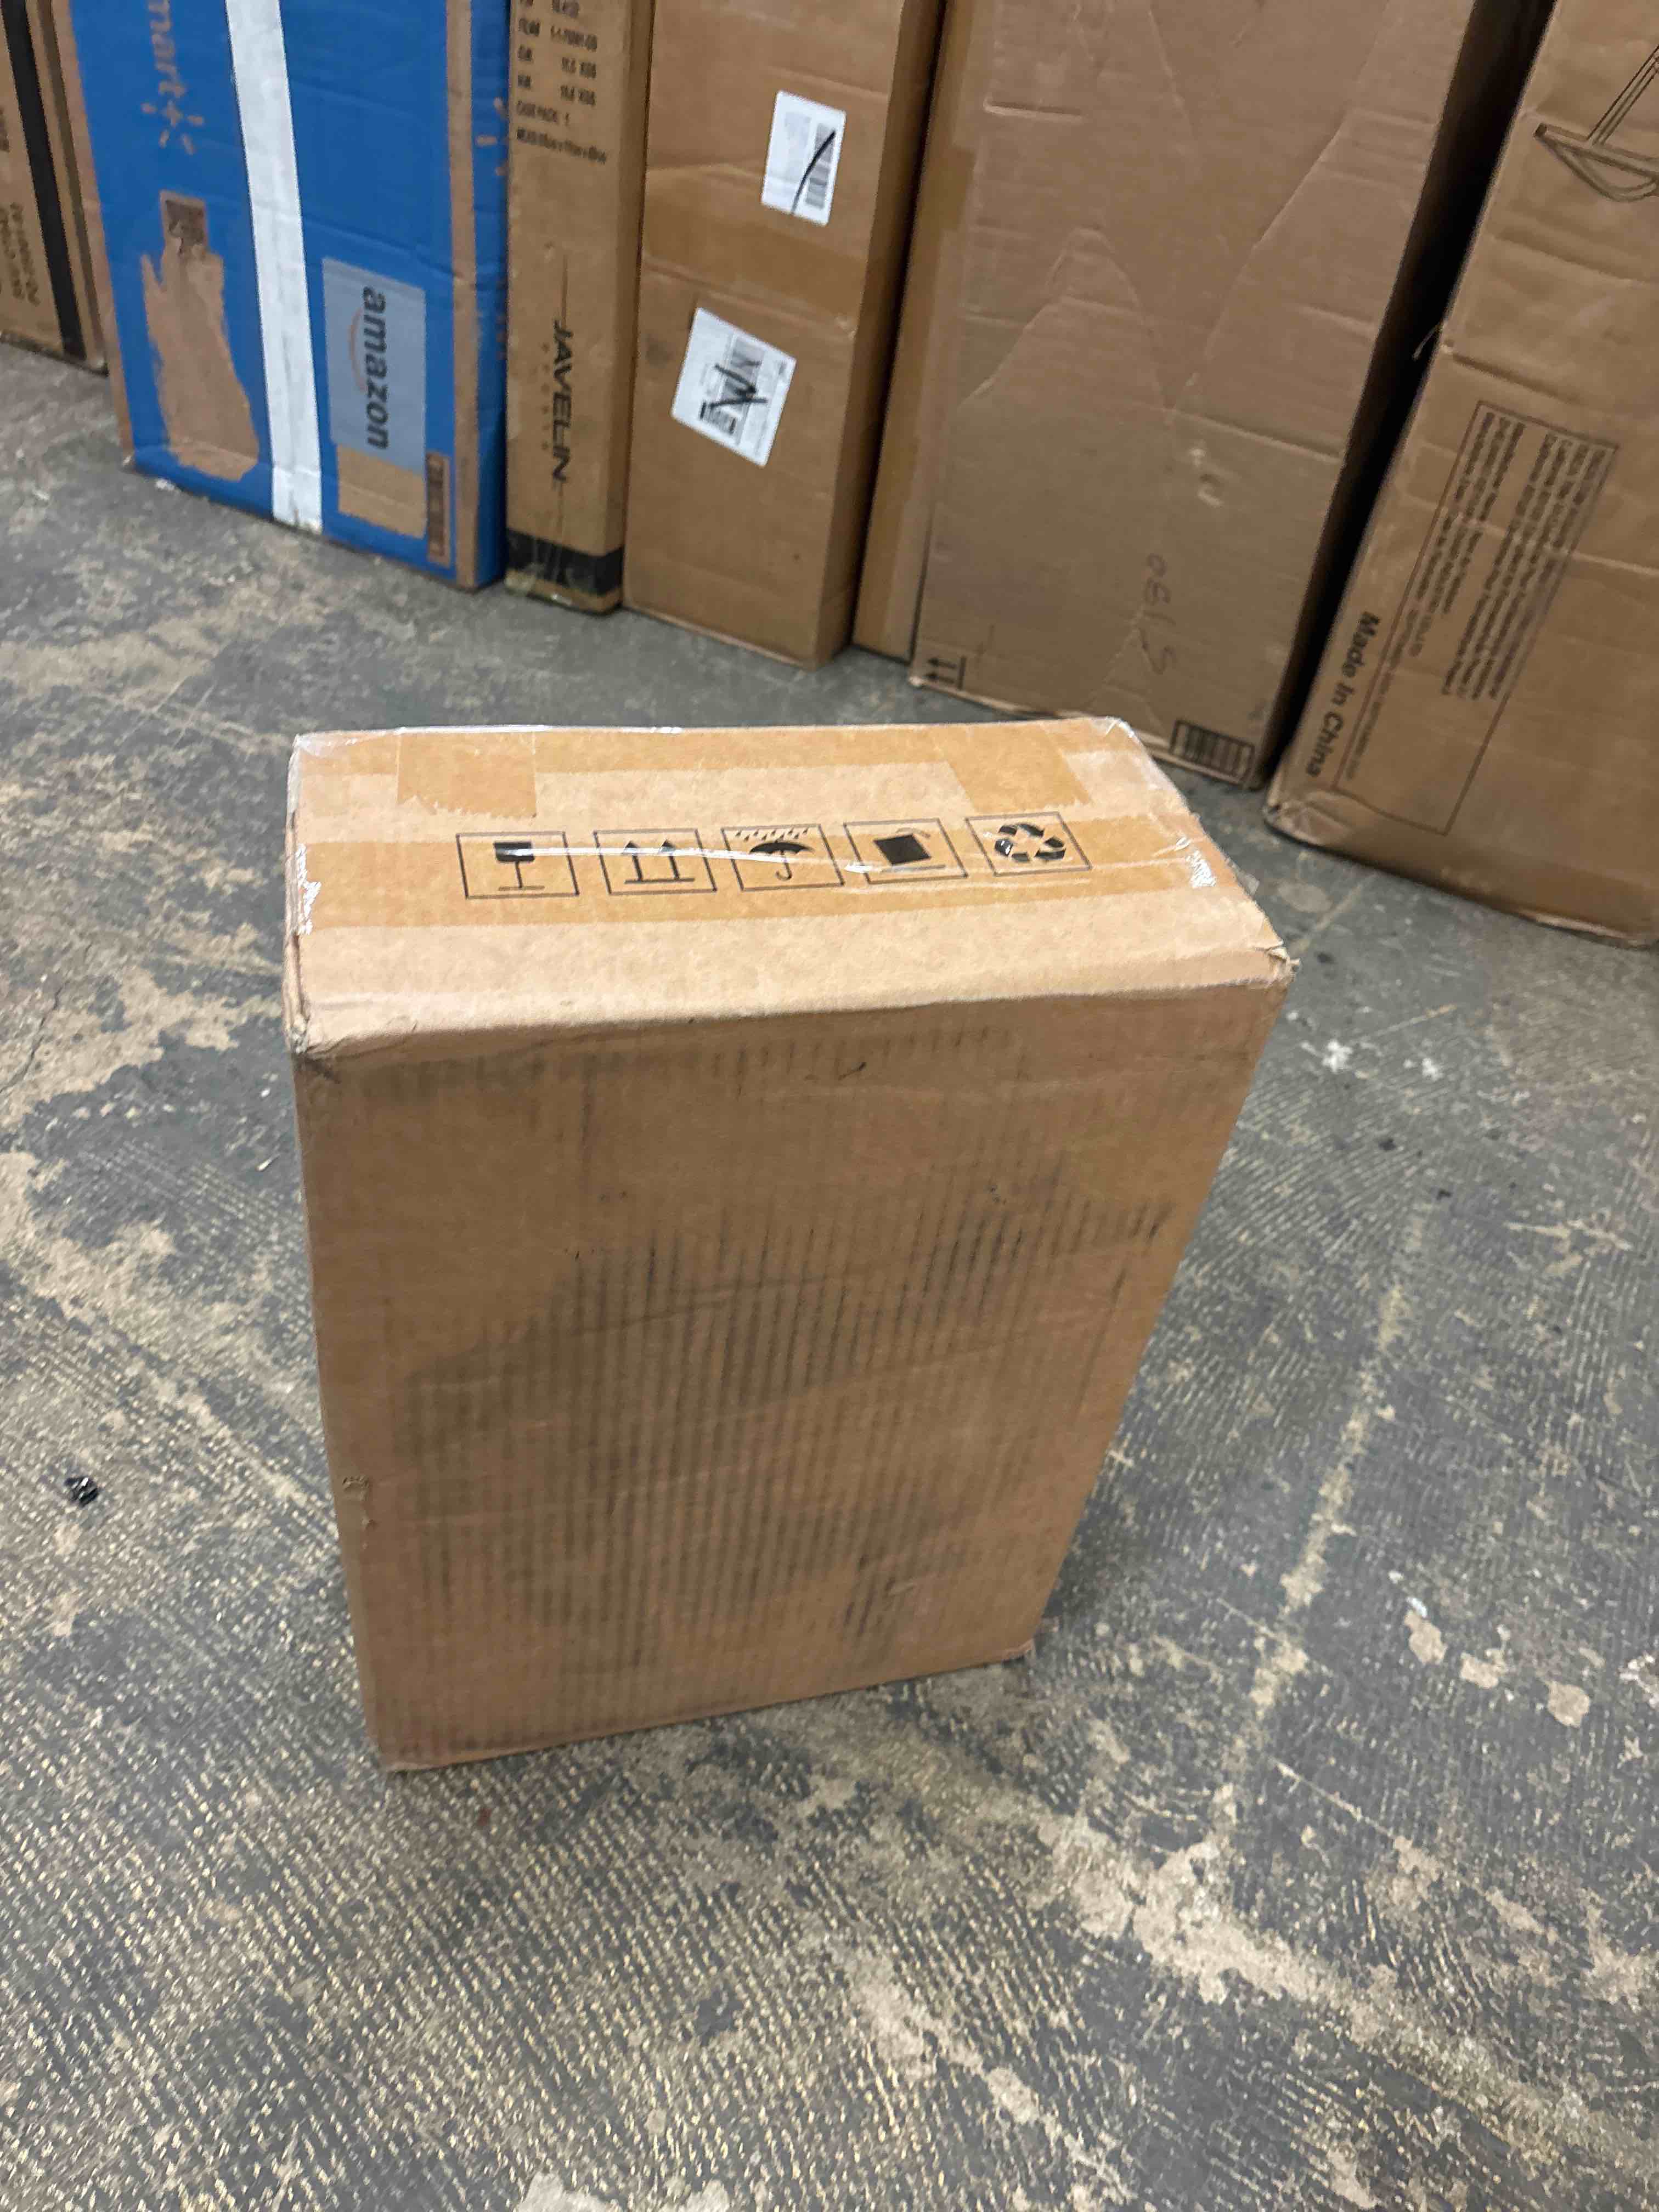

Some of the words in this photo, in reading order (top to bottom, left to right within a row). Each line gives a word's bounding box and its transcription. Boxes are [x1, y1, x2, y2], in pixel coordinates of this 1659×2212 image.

[362, 286, 389, 450] amazon
[552, 319, 573, 485] JAVELIN
[1342, 611, 1380, 678] Made
[1306, 711, 1344, 777] China
